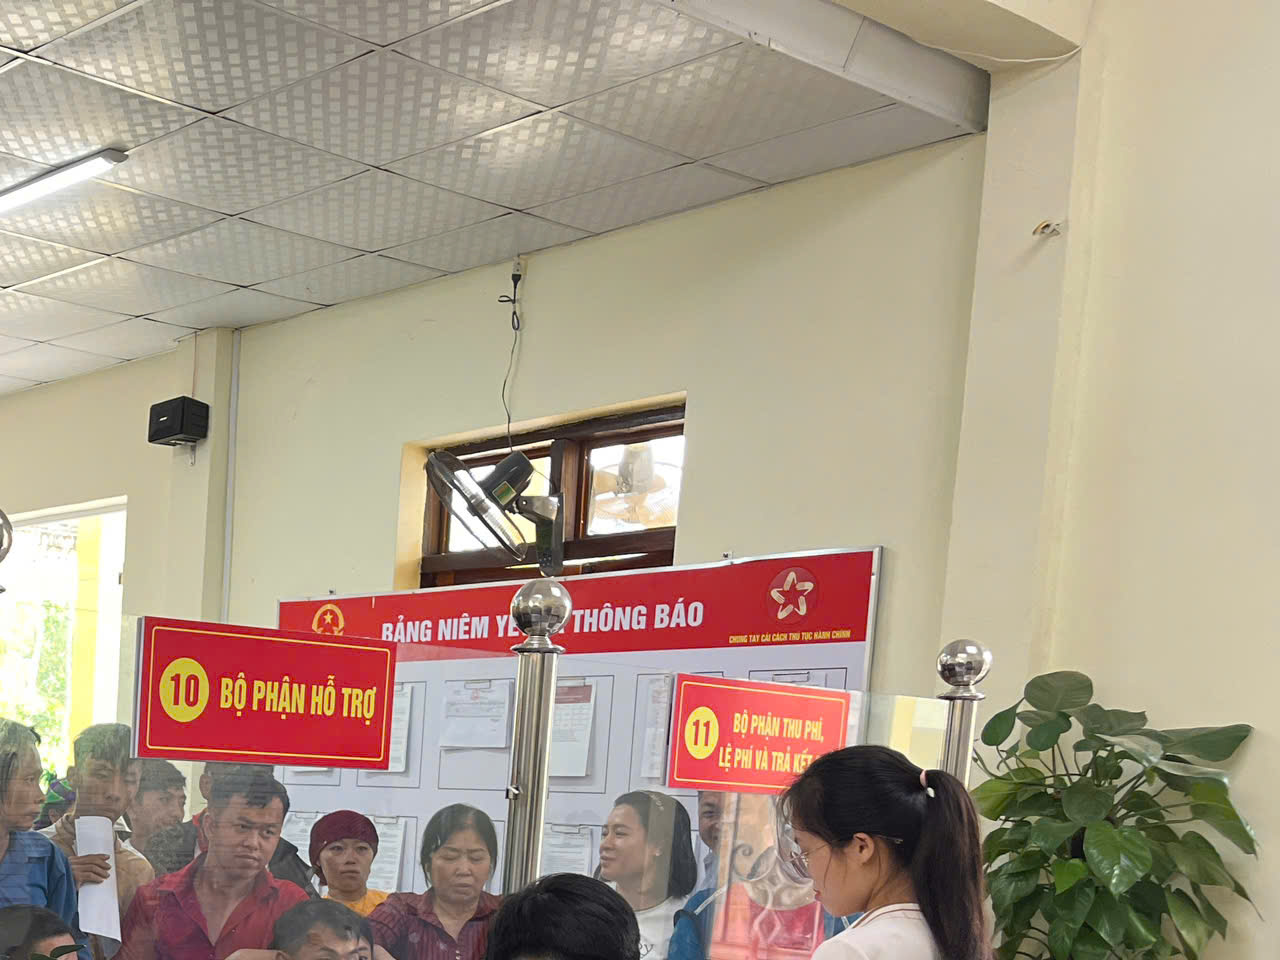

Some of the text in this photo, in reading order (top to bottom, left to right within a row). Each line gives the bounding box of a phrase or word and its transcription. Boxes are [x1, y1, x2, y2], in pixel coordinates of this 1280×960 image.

[381, 615, 432, 643] BẢNG
[437, 613, 489, 641] NIÊM
[571, 603, 651, 633] THÔNG
[654, 597, 705, 629] BÁO
[170, 673, 200, 708] 10
[220, 672, 377, 726] BỘ PHẬN HỖ TRỢ
[692, 719, 711, 747] 11
[733, 709, 824, 742] BỘ PHẬN THU PHÍ,
[718, 743, 731, 772] LỆ
[734, 745, 753, 769] PHÍ
[755, 745, 769, 770] VÀ
[771, 746, 790, 773] TRẢ
